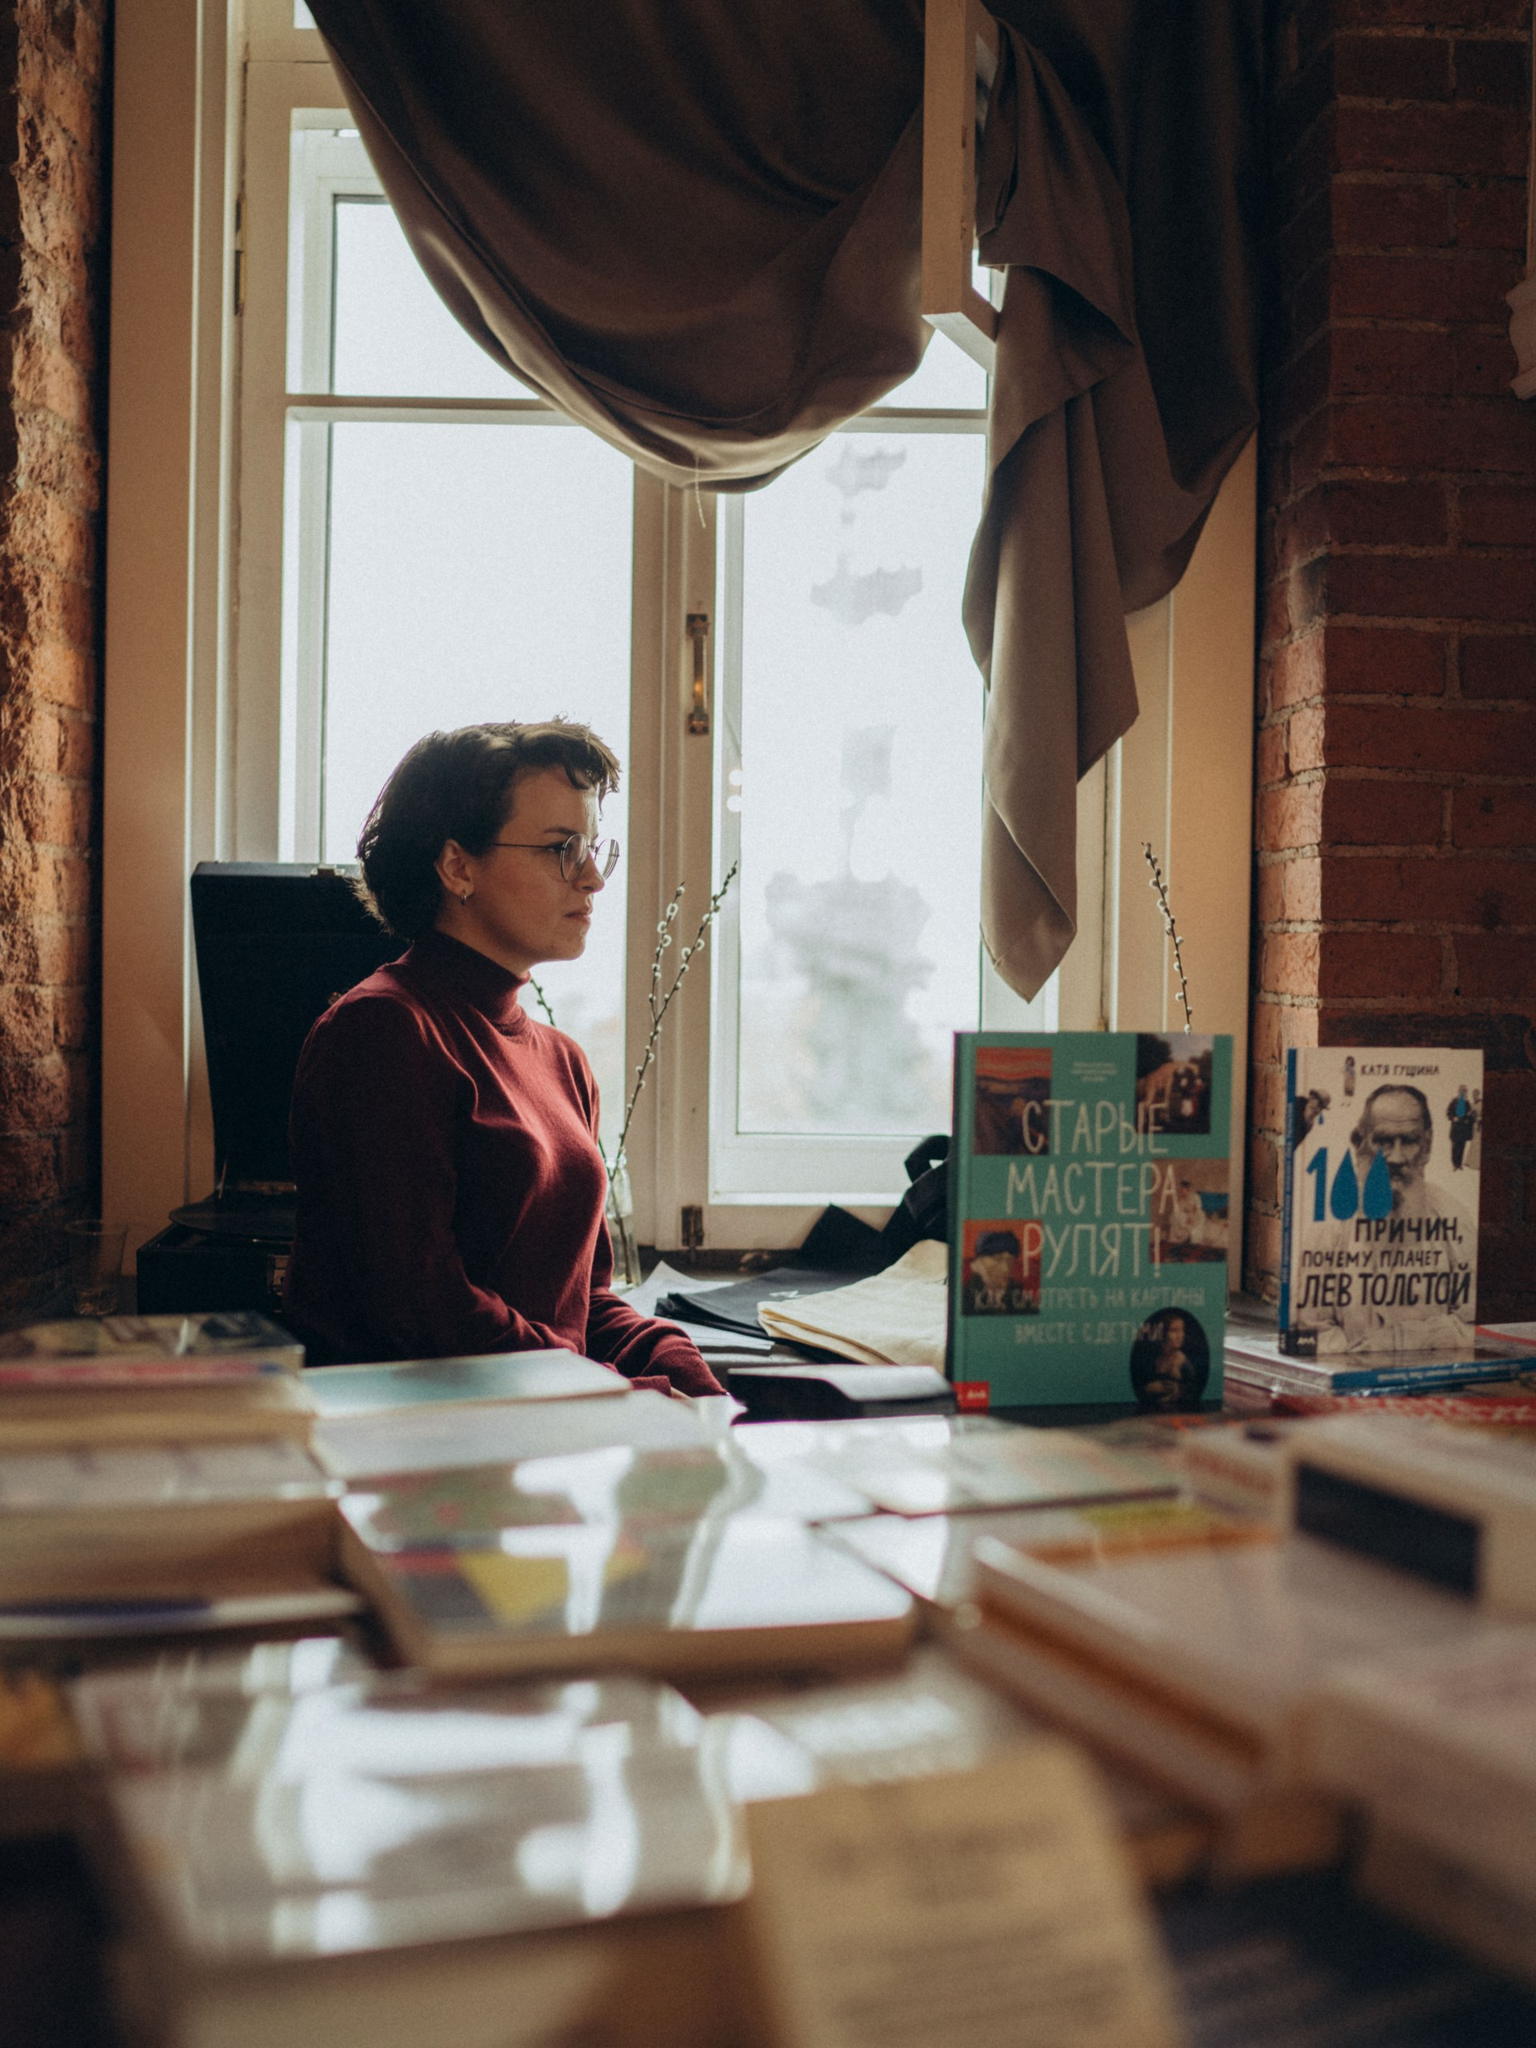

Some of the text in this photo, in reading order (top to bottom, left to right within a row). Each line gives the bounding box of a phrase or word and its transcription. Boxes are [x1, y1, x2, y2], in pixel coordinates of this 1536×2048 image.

[1022, 1100, 1169, 1155] СТАРЫЕ
[1006, 1161, 1181, 1217] МАСТЕРА
[1306, 1147, 1394, 1222] 100
[1022, 1222, 1162, 1278] РУЛЯТ!
[1355, 1217, 1463, 1245] ПРИЧИН,
[1297, 1262, 1472, 1309] ЛЕВ ТОЛСТОЙ
[1302, 1250, 1443, 1268] ПОЧЕМУ ПЛАЧЕТ
